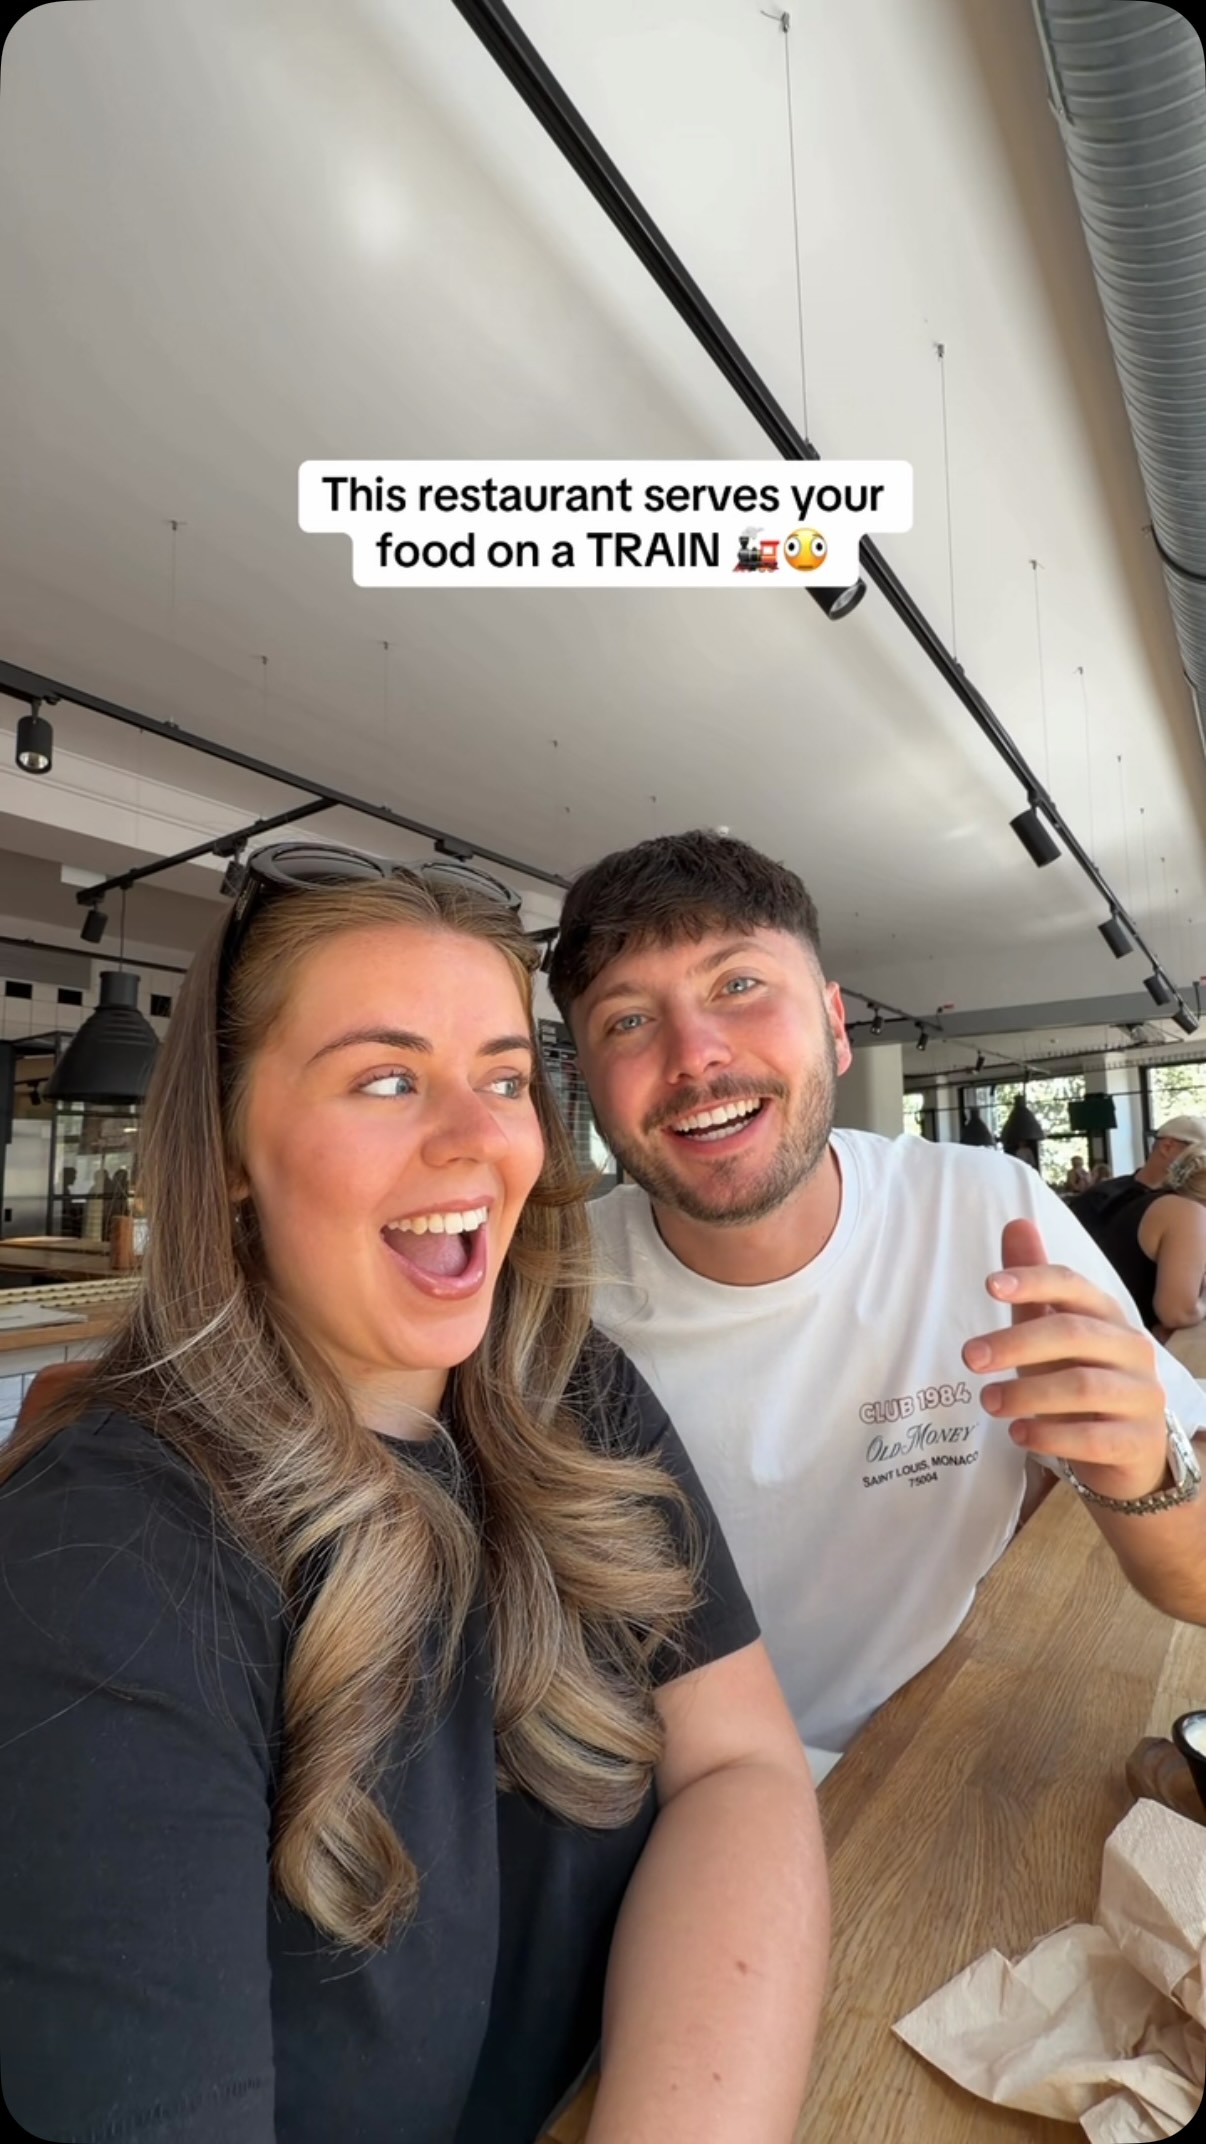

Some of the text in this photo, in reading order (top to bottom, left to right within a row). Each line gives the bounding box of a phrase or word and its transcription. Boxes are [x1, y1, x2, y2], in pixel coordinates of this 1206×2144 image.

[859, 1382, 972, 1425] CLUB 1984
[862, 1470, 894, 1488] SAINT
[908, 1471, 938, 1488] 75004
